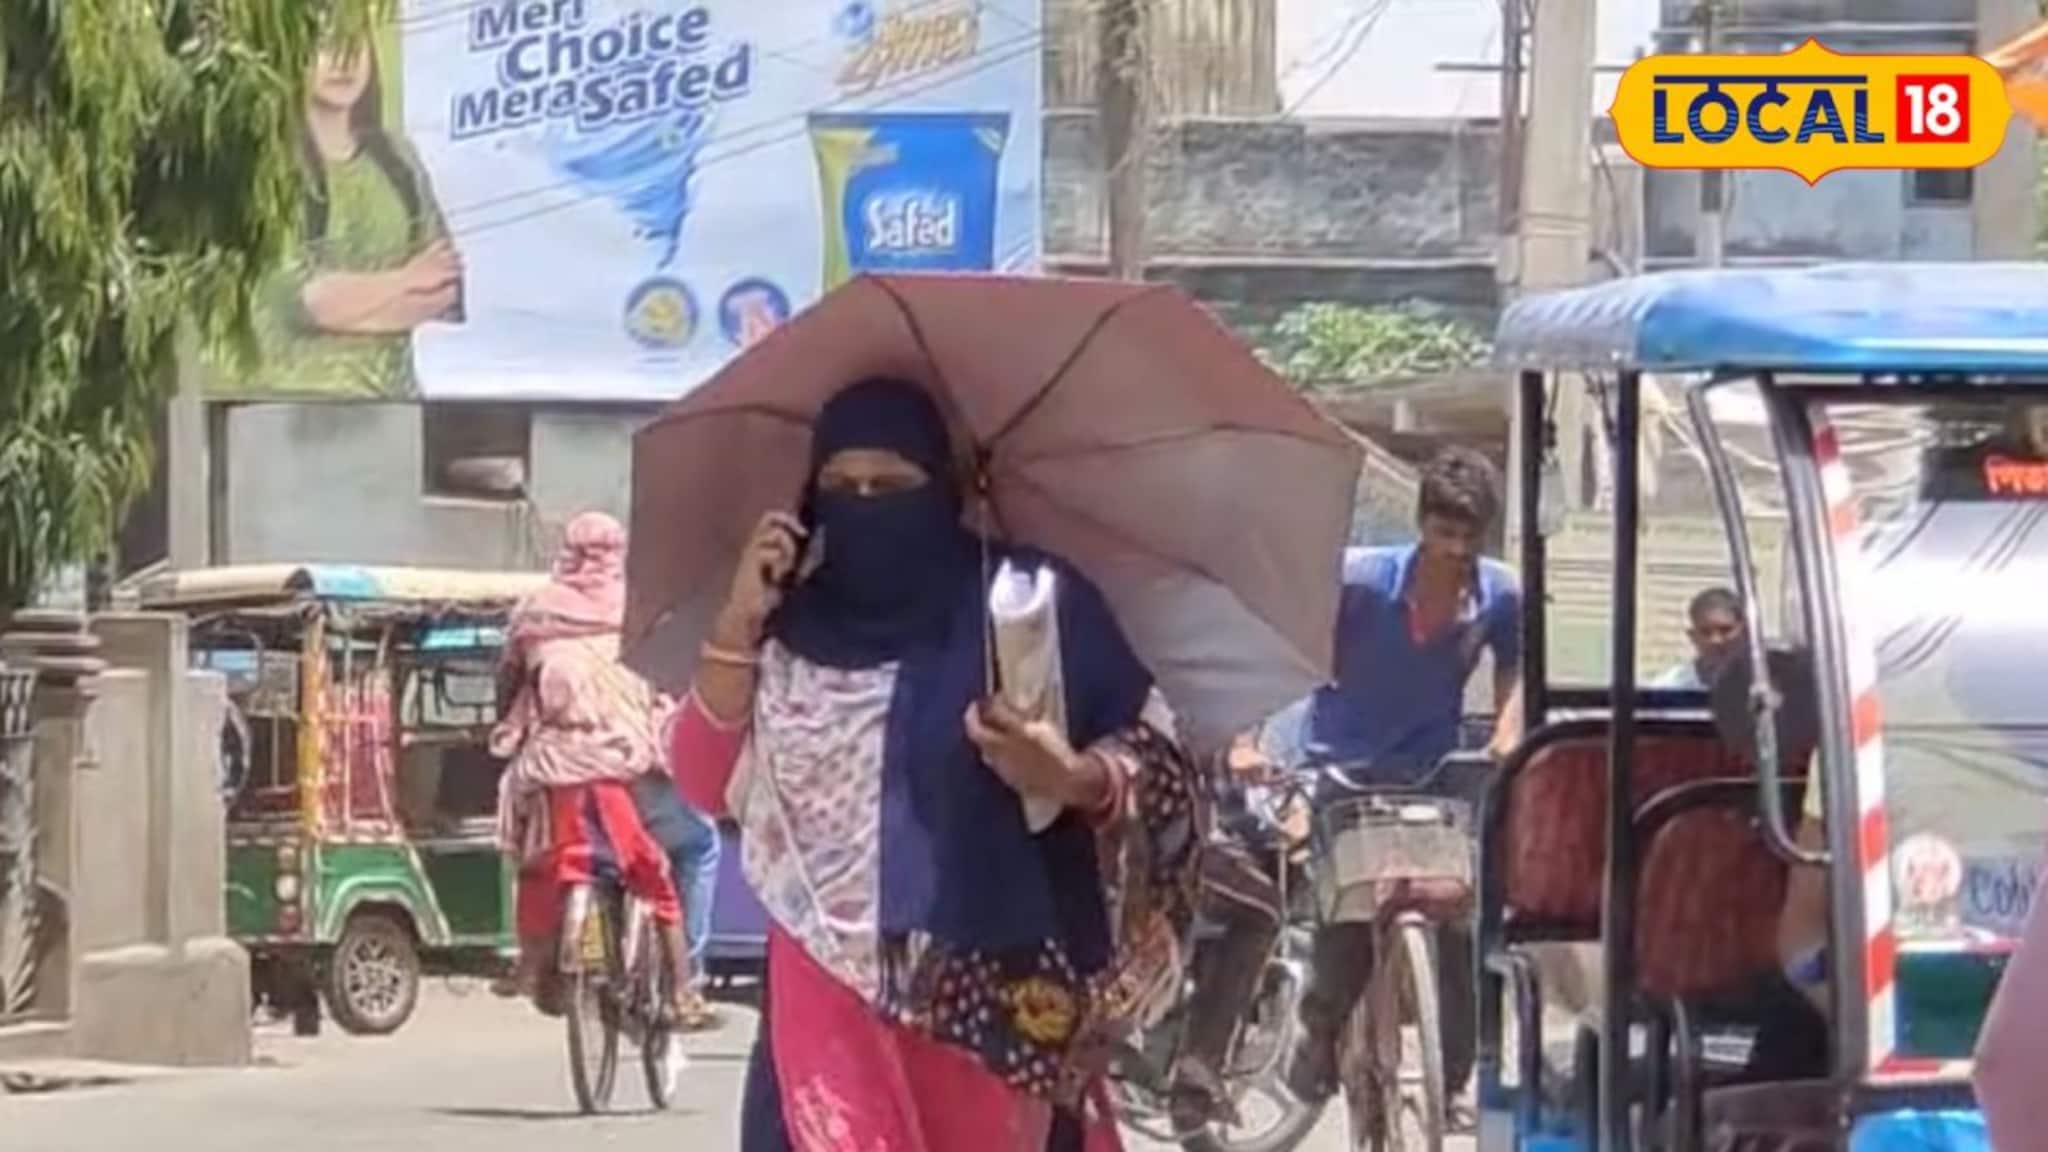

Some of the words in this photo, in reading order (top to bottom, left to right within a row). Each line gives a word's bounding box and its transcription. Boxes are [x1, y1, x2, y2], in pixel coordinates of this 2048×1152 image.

[475, 0, 584, 42] Meri
[504, 6, 710, 83] Choice
[868, 198, 956, 250] Safed
